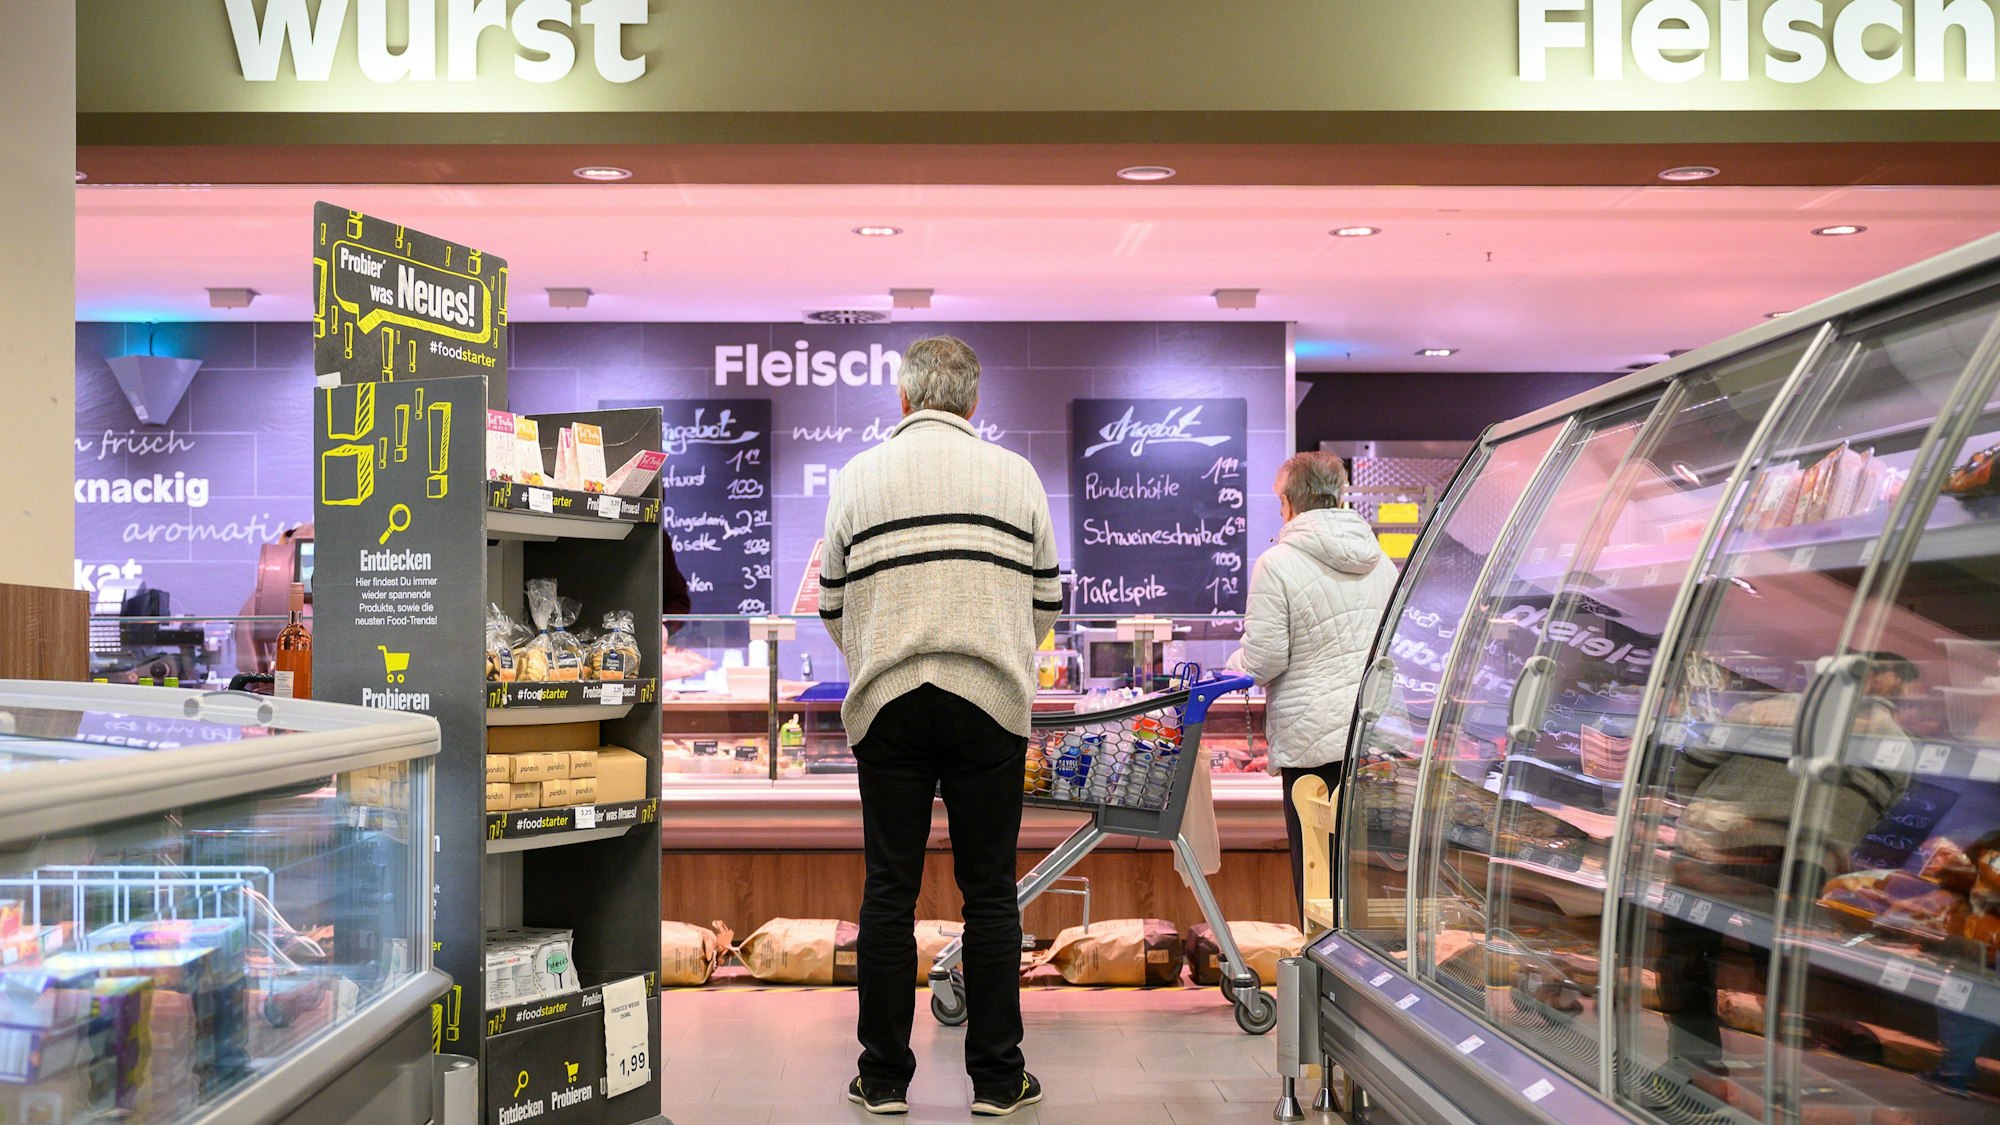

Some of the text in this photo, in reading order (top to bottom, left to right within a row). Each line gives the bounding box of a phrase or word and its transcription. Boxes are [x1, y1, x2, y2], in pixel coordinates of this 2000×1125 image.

[225, 0, 648, 84] Wurst
[1519, 0, 1997, 84] Fleisch
[370, 264, 476, 328] was Neues!
[429, 340, 497, 368] #foodstarter
[715, 340, 903, 387] Fleisch
[662, 408, 748, 454] ngebot
[793, 417, 1006, 443] nur da te
[1094, 406, 1212, 457] Angebot
[97, 429, 195, 460] frisch
[661, 464, 707, 489] atwurst
[1085, 472, 1180, 500] Rinderhüfte
[587, 497, 600, 511] Pro
[1218, 487, 1244, 508] 100g
[122, 513, 302, 544] aromatis
[360, 548, 431, 572] Entdecken
[1211, 552, 1243, 573] 100g
[355, 576, 438, 587] Hier findest Du immer
[686, 572, 714, 592] ken
[1078, 575, 1168, 606] Tafelspitz
[359, 602, 434, 614] Produkte, sowie die
[361, 590, 431, 602] wieder spannende
[355, 615, 438, 626] neusten Food-Trends!
[362, 687, 430, 711] Probieren
[582, 685, 601, 699] Probie
[517, 816, 569, 830] #foodstarter
[606, 810, 618, 821] was
[618, 806, 637, 820] Neues!
[516, 1003, 568, 1022] #foodstarter
[619, 1051, 645, 1077] 1,99
[551, 1084, 592, 1111] Probieren
[499, 1099, 544, 1125] Entdecken
